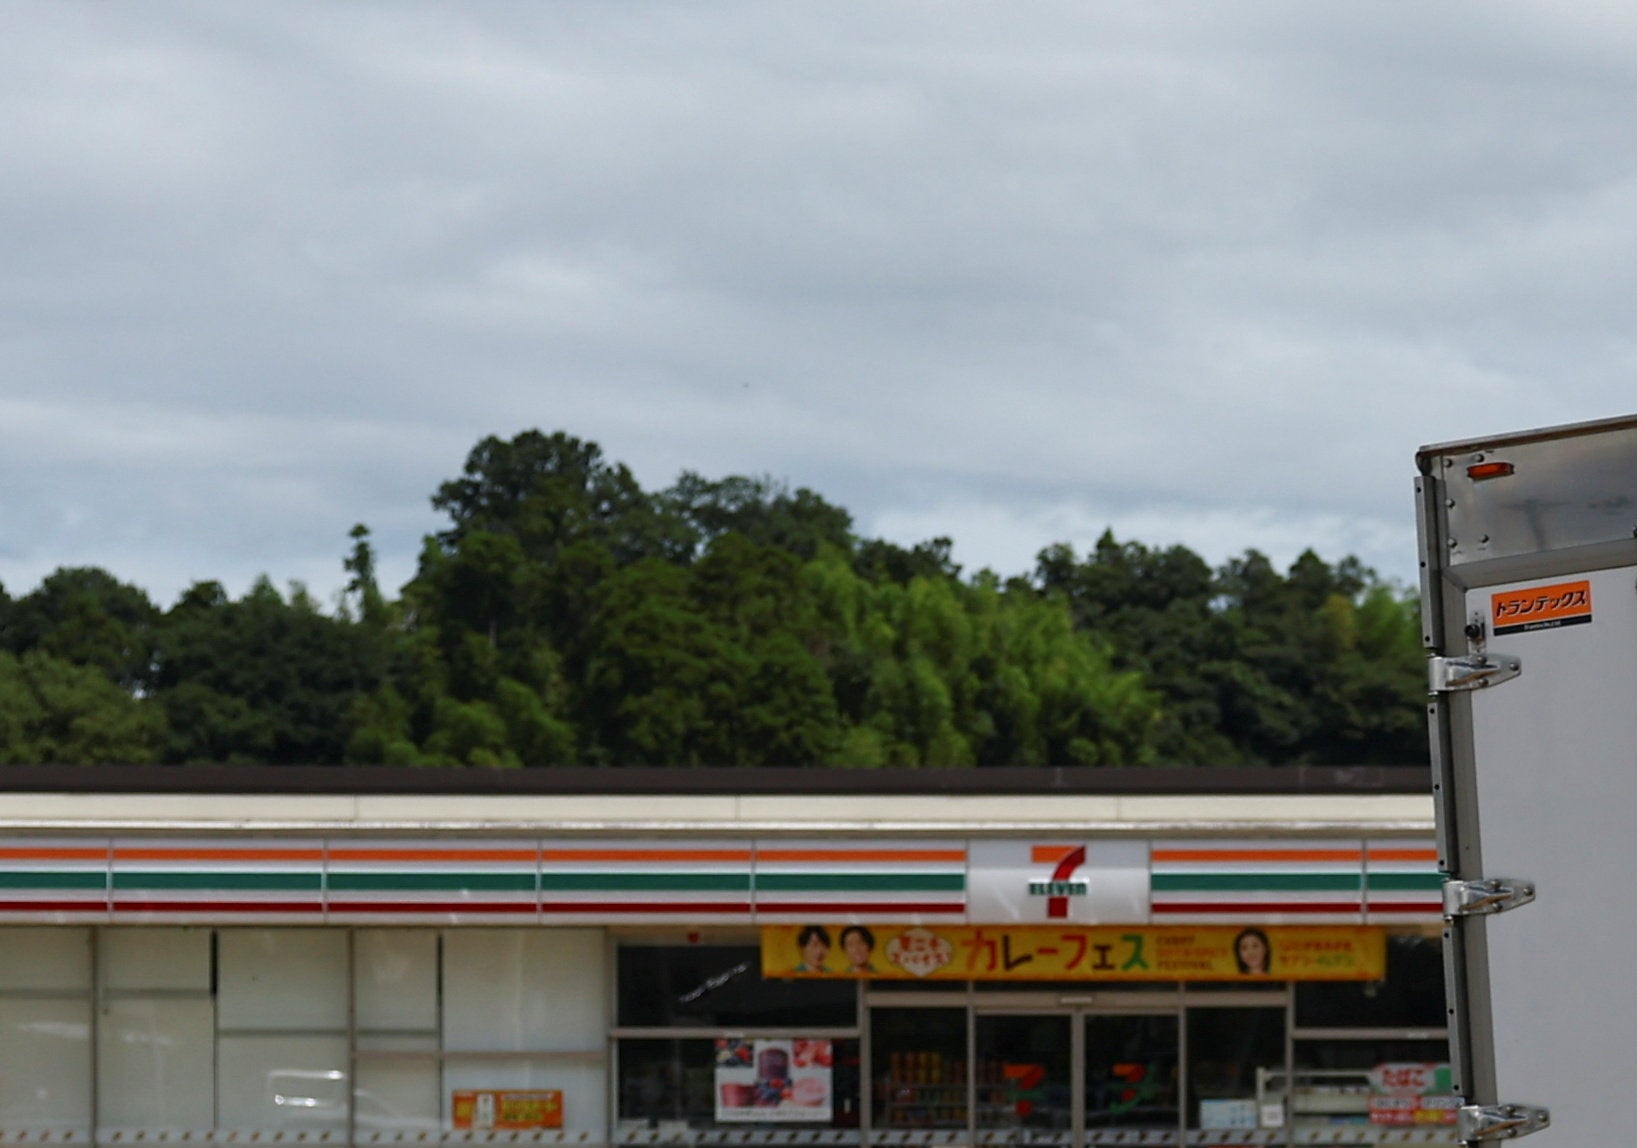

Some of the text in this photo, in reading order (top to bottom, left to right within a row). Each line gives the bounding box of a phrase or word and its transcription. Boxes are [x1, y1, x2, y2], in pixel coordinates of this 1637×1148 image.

[1496, 590, 1587, 618] トランテックス
[961, 930, 1148, 972] カレーフェス
